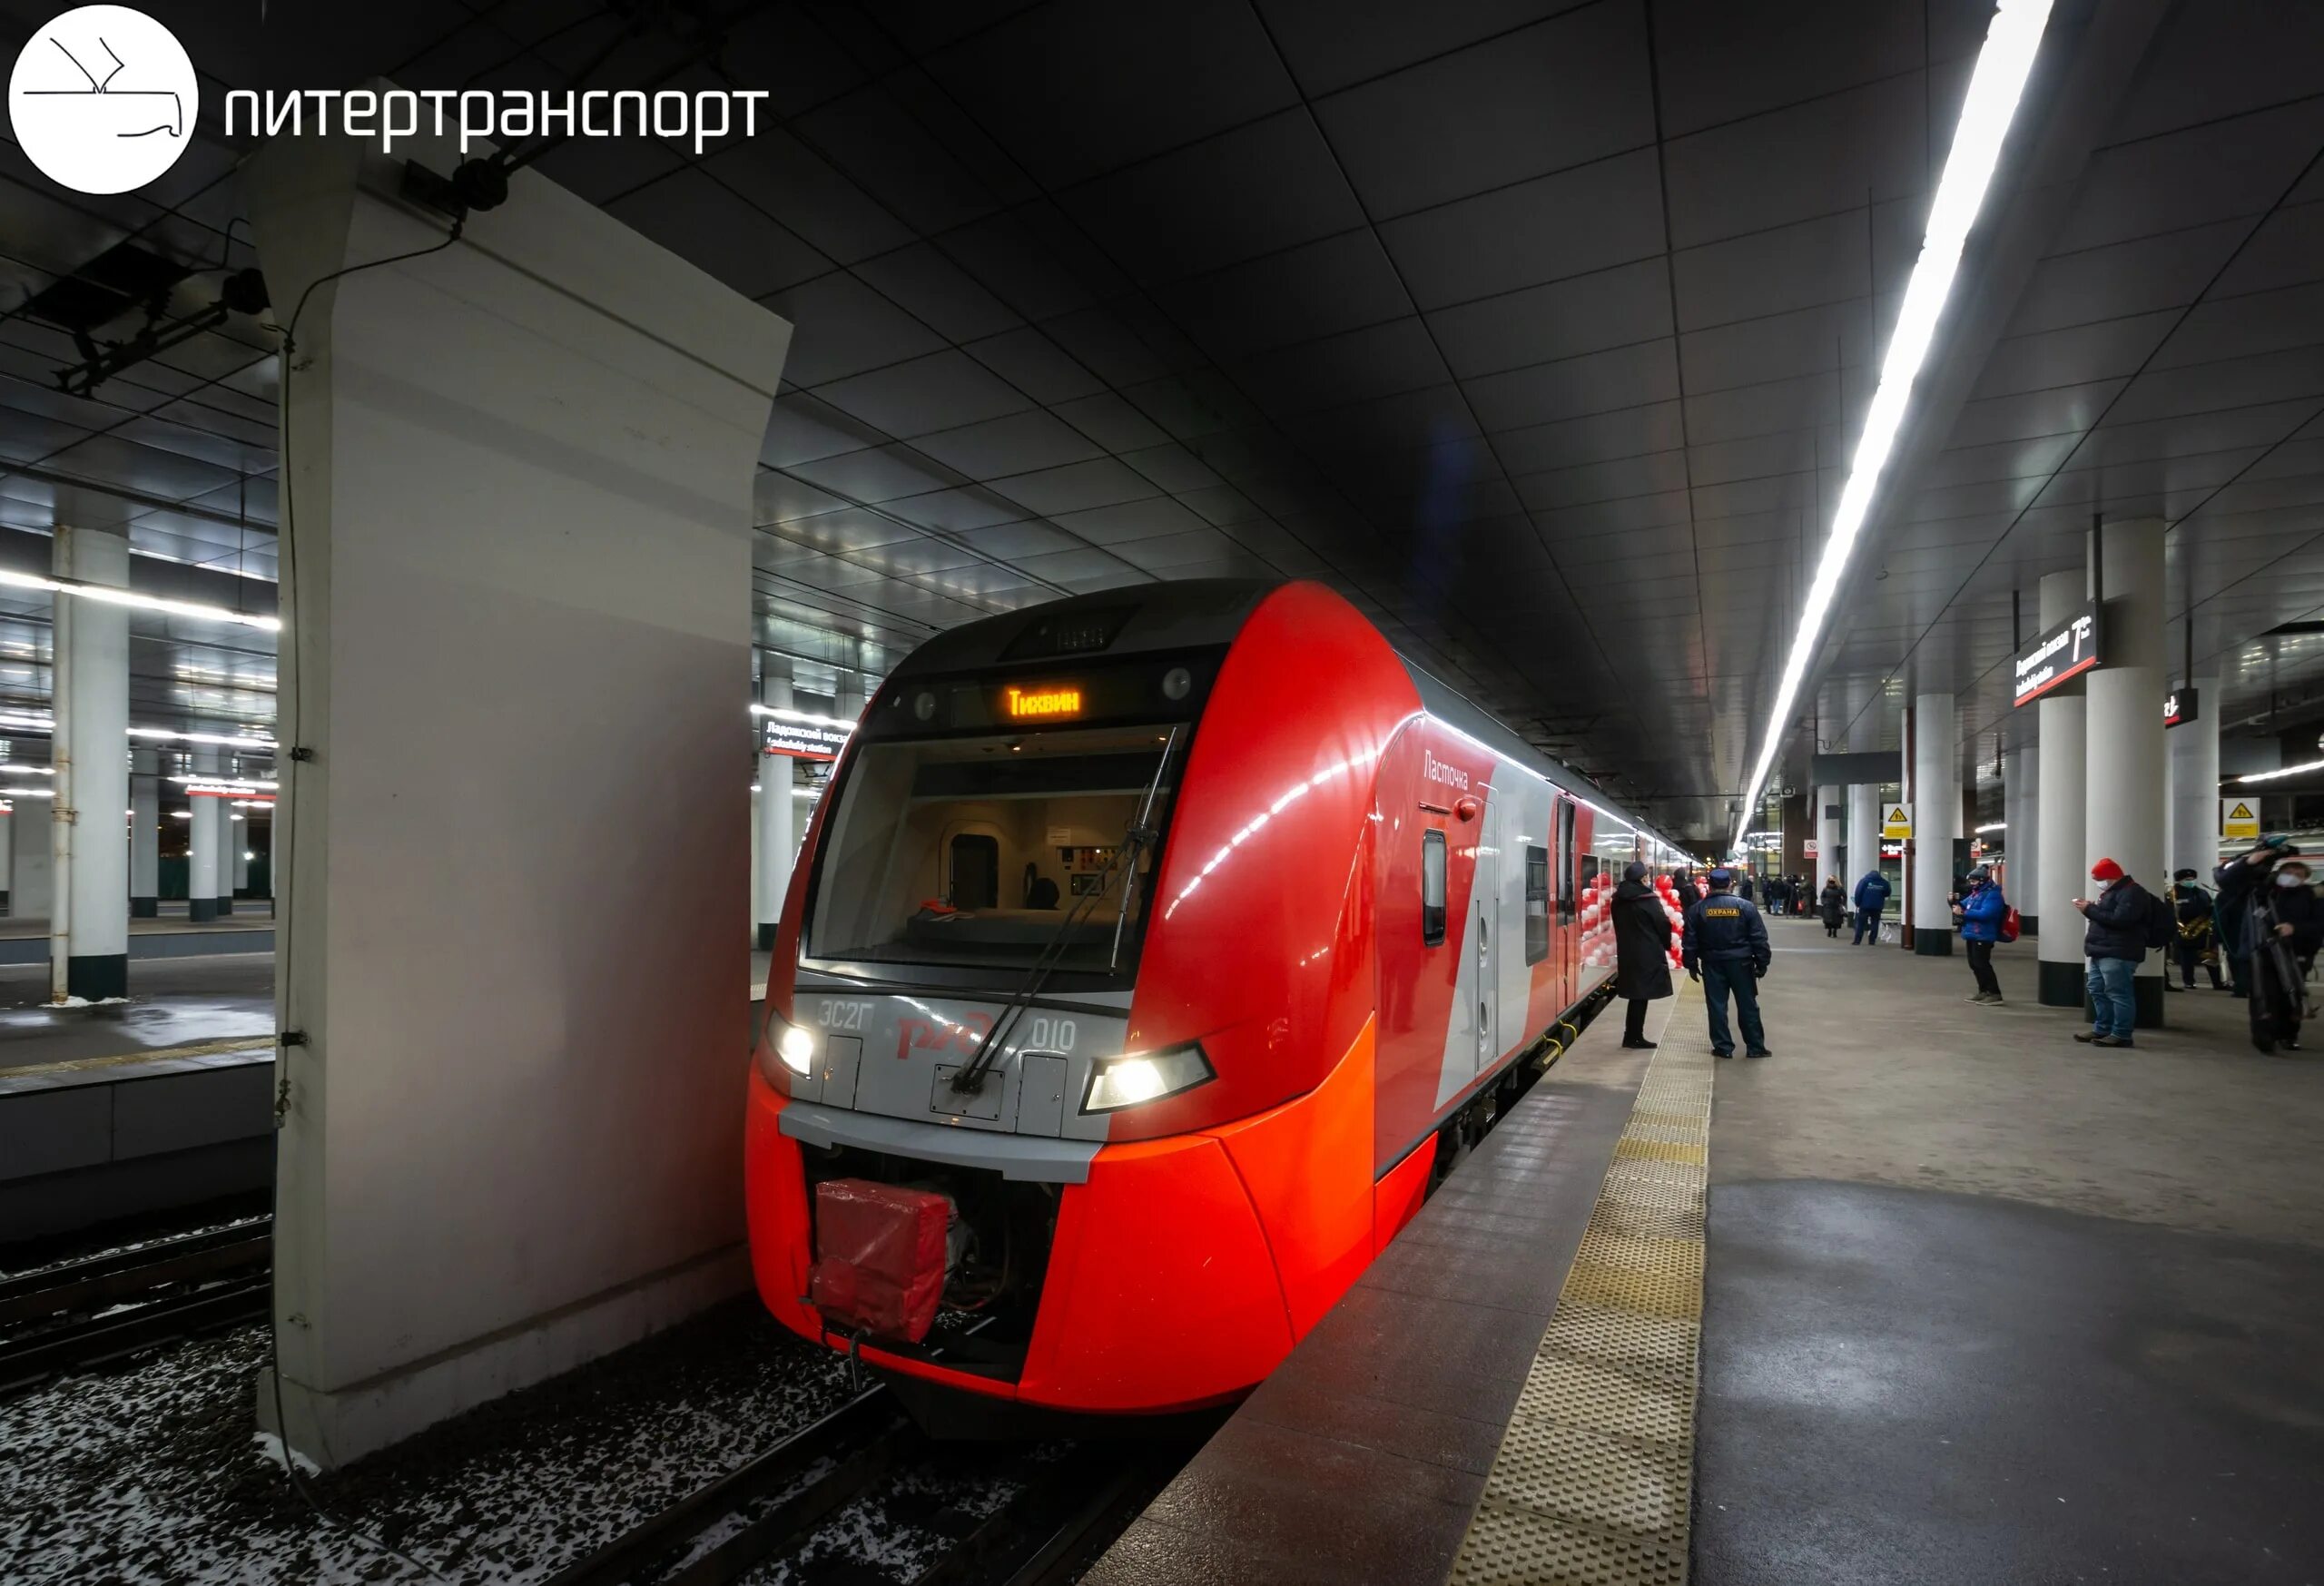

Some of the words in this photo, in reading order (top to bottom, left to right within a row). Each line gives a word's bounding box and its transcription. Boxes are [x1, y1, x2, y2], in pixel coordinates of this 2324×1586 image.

[1009, 690, 1079, 716] Тихвин
[1423, 749, 1469, 791] Ласточка
[1707, 908, 1738, 916] ОХРАНА
[818, 1000, 874, 1030] ЭС2Г
[1031, 1017, 1077, 1051] 010
